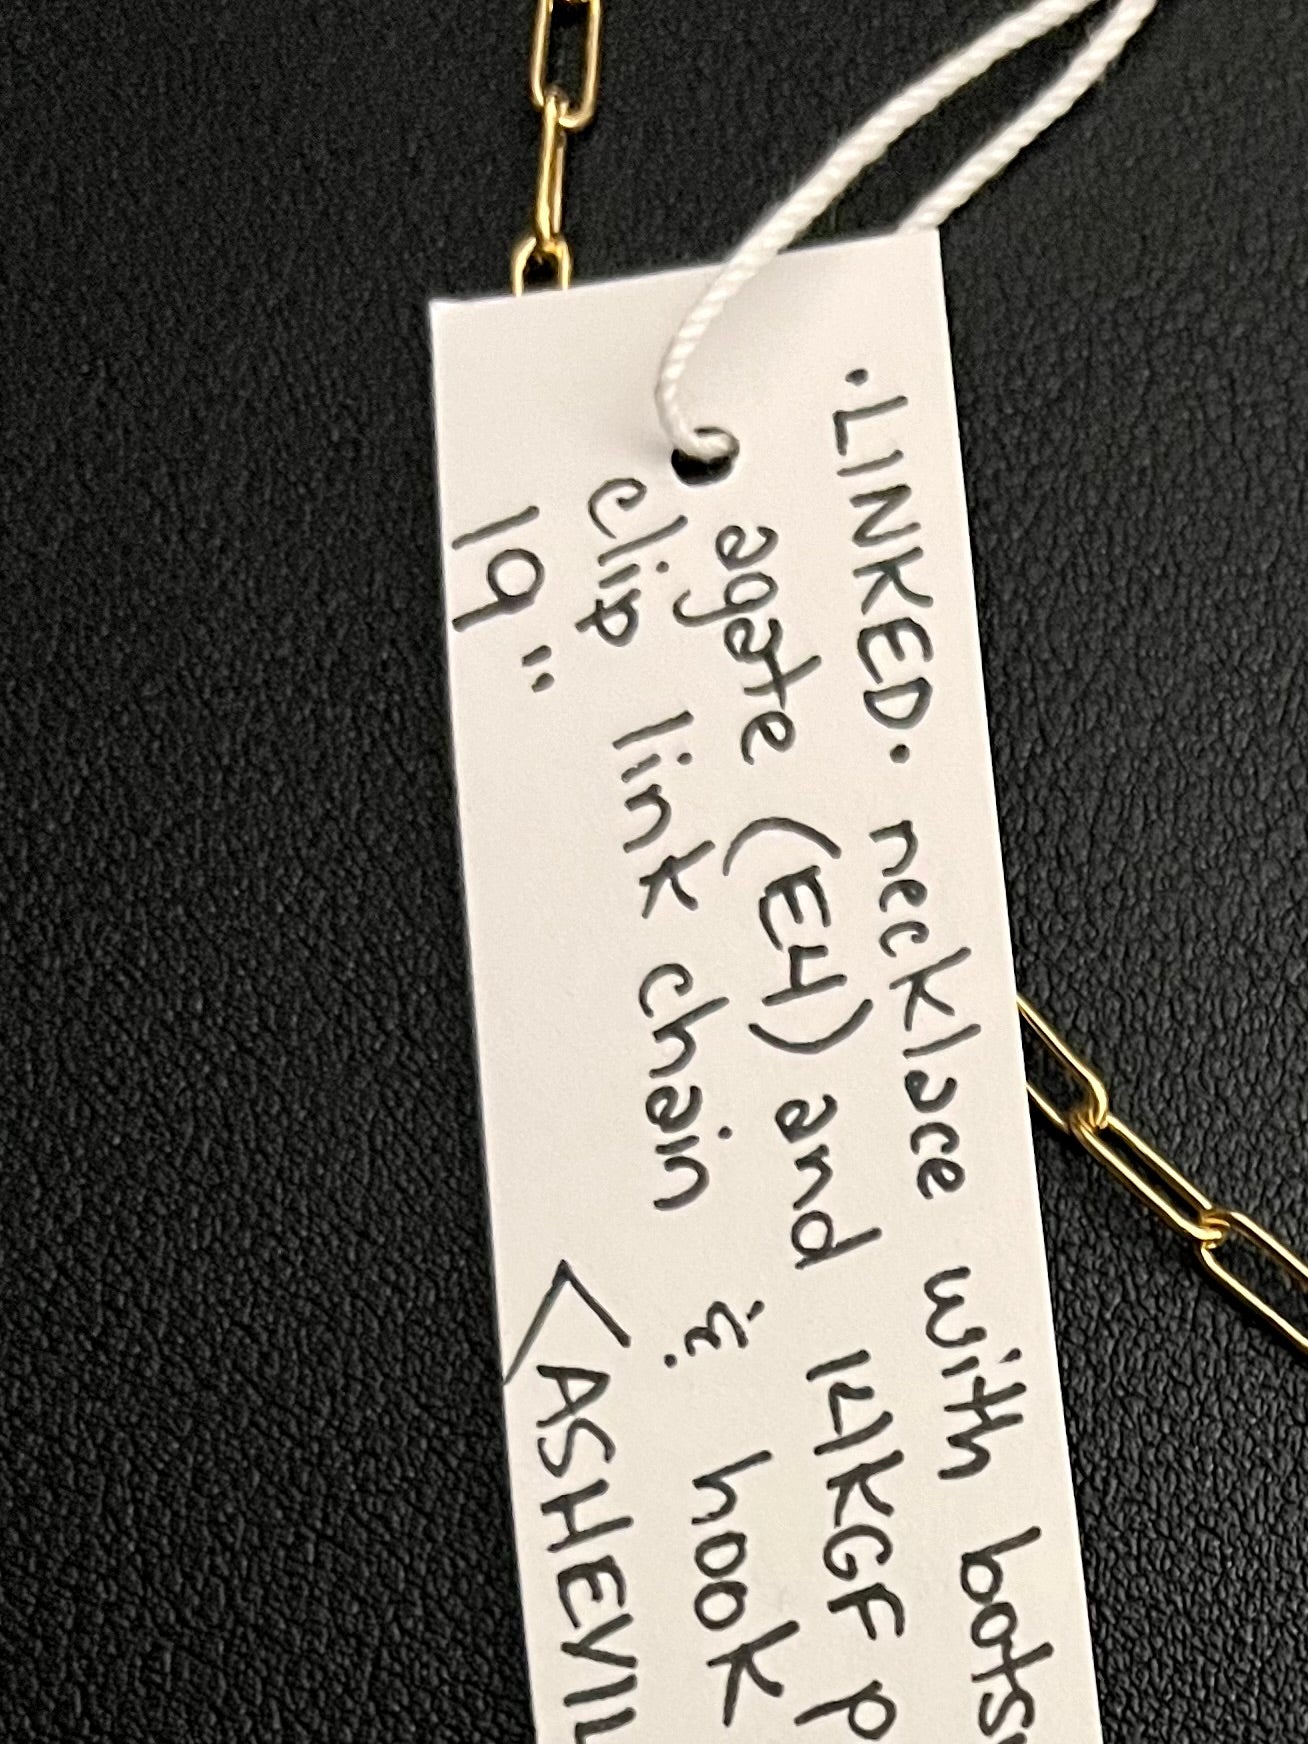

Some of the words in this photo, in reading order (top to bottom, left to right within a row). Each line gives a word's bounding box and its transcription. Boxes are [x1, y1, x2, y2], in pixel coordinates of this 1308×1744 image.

[575, 478, 687, 645] clip
[673, 525, 821, 765] agate
[613, 711, 714, 918] link
[723, 817, 872, 1053] (E4)
[870, 820, 980, 1199] necklace
[639, 963, 731, 1210] chain
[775, 1095, 881, 1269] and
[924, 1267, 1026, 1479] with
[692, 1450, 799, 1727] hook
[806, 1350, 905, 1640] 14KGF
